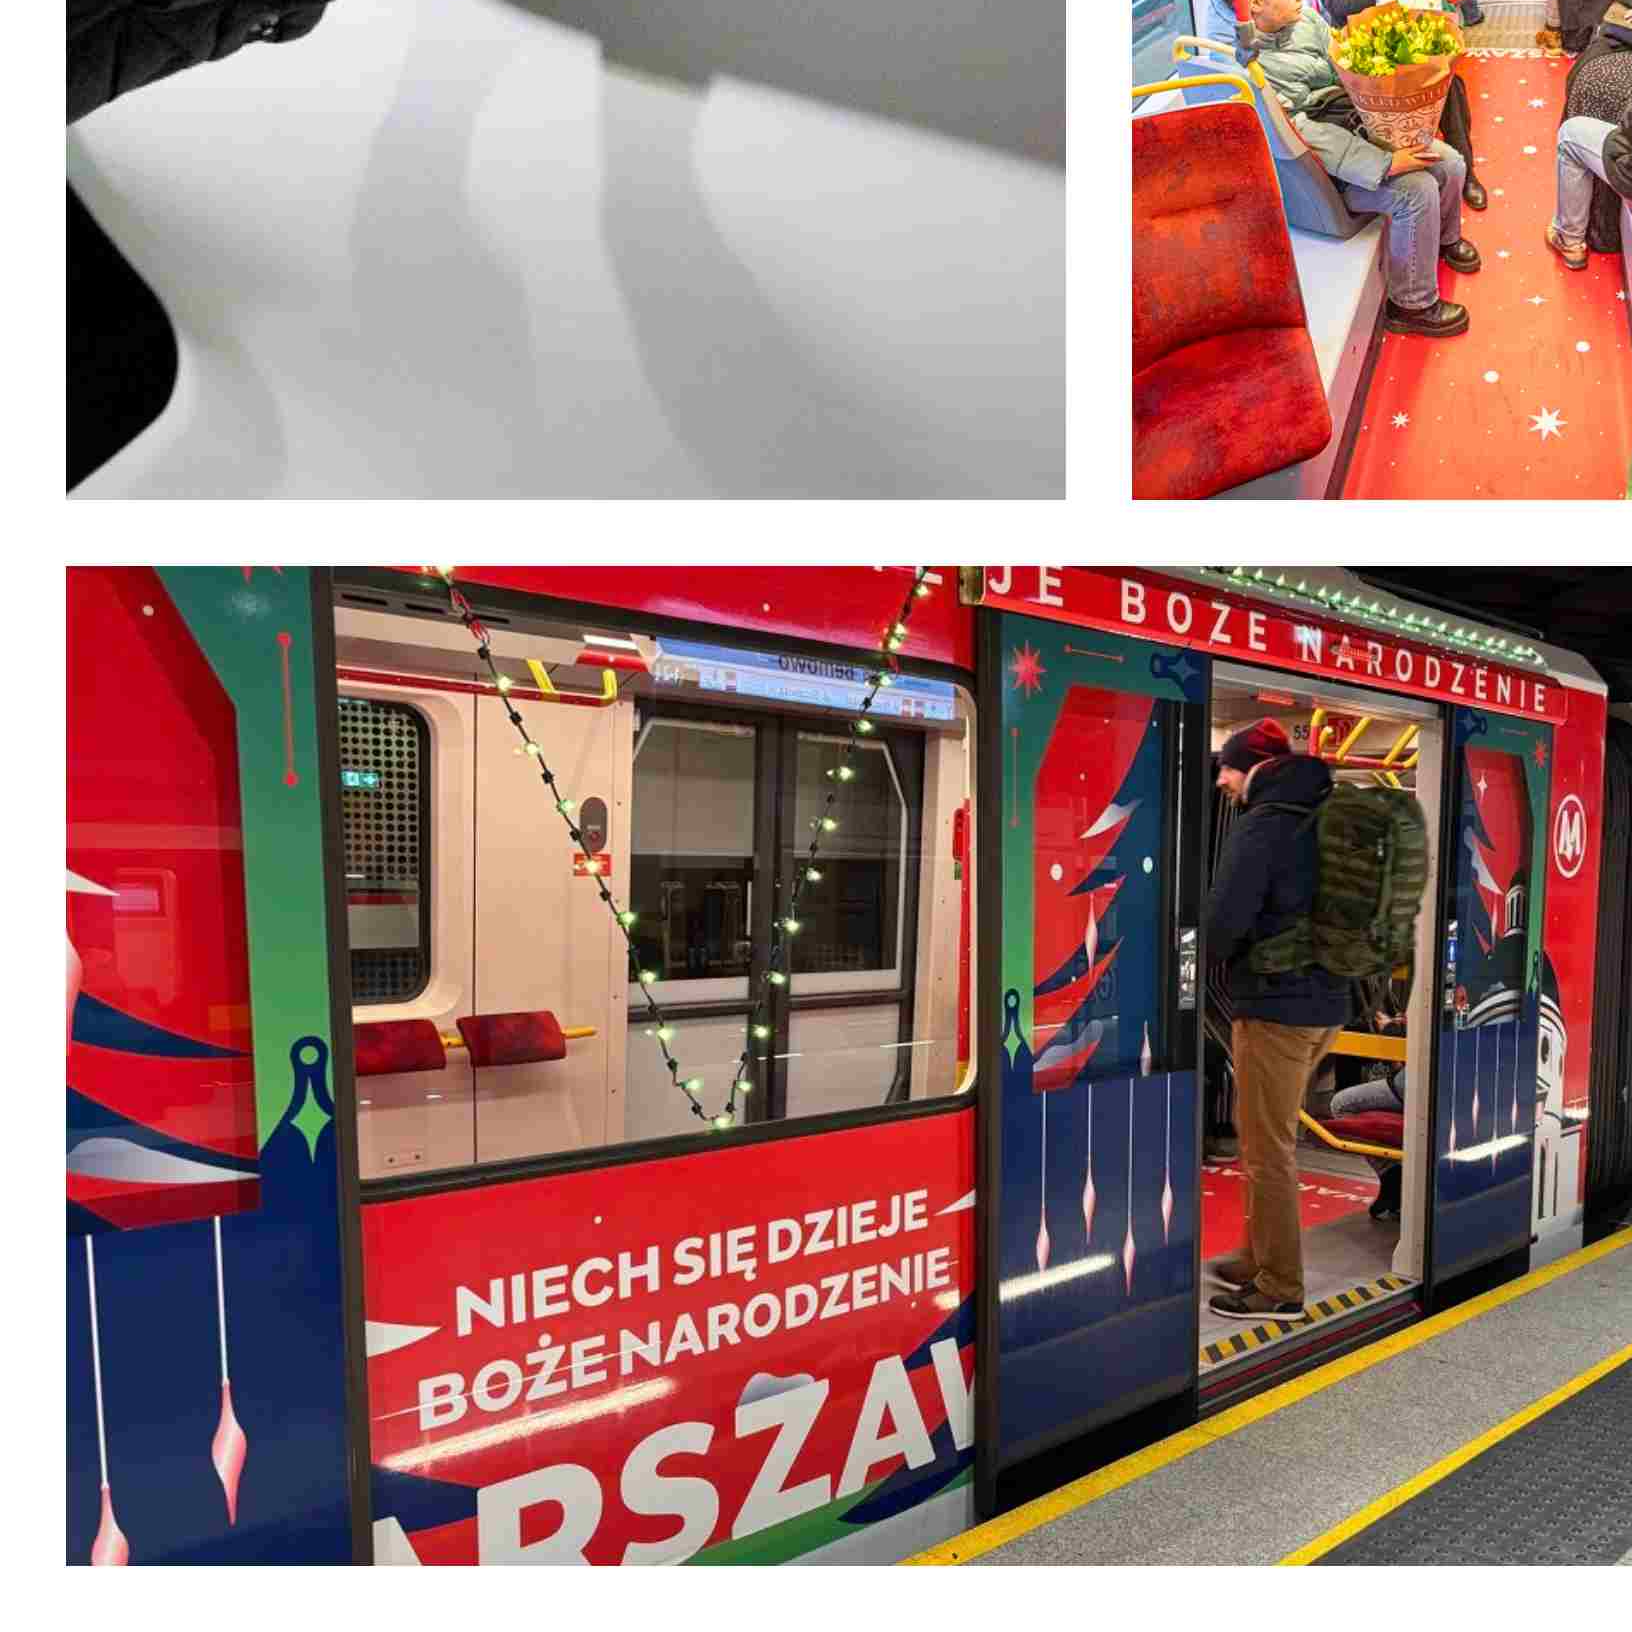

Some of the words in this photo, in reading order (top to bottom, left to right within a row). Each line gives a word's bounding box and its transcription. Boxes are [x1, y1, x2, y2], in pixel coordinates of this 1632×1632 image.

[1301, 624, 1546, 713] NARODZENIE
[454, 1246, 661, 1337] NIECH
[672, 1225, 760, 1283] SIĘ
[767, 1189, 930, 1264] DZIEJE
[417, 1332, 607, 1432] BOŻE
[618, 1246, 952, 1376] NARODZENIE
